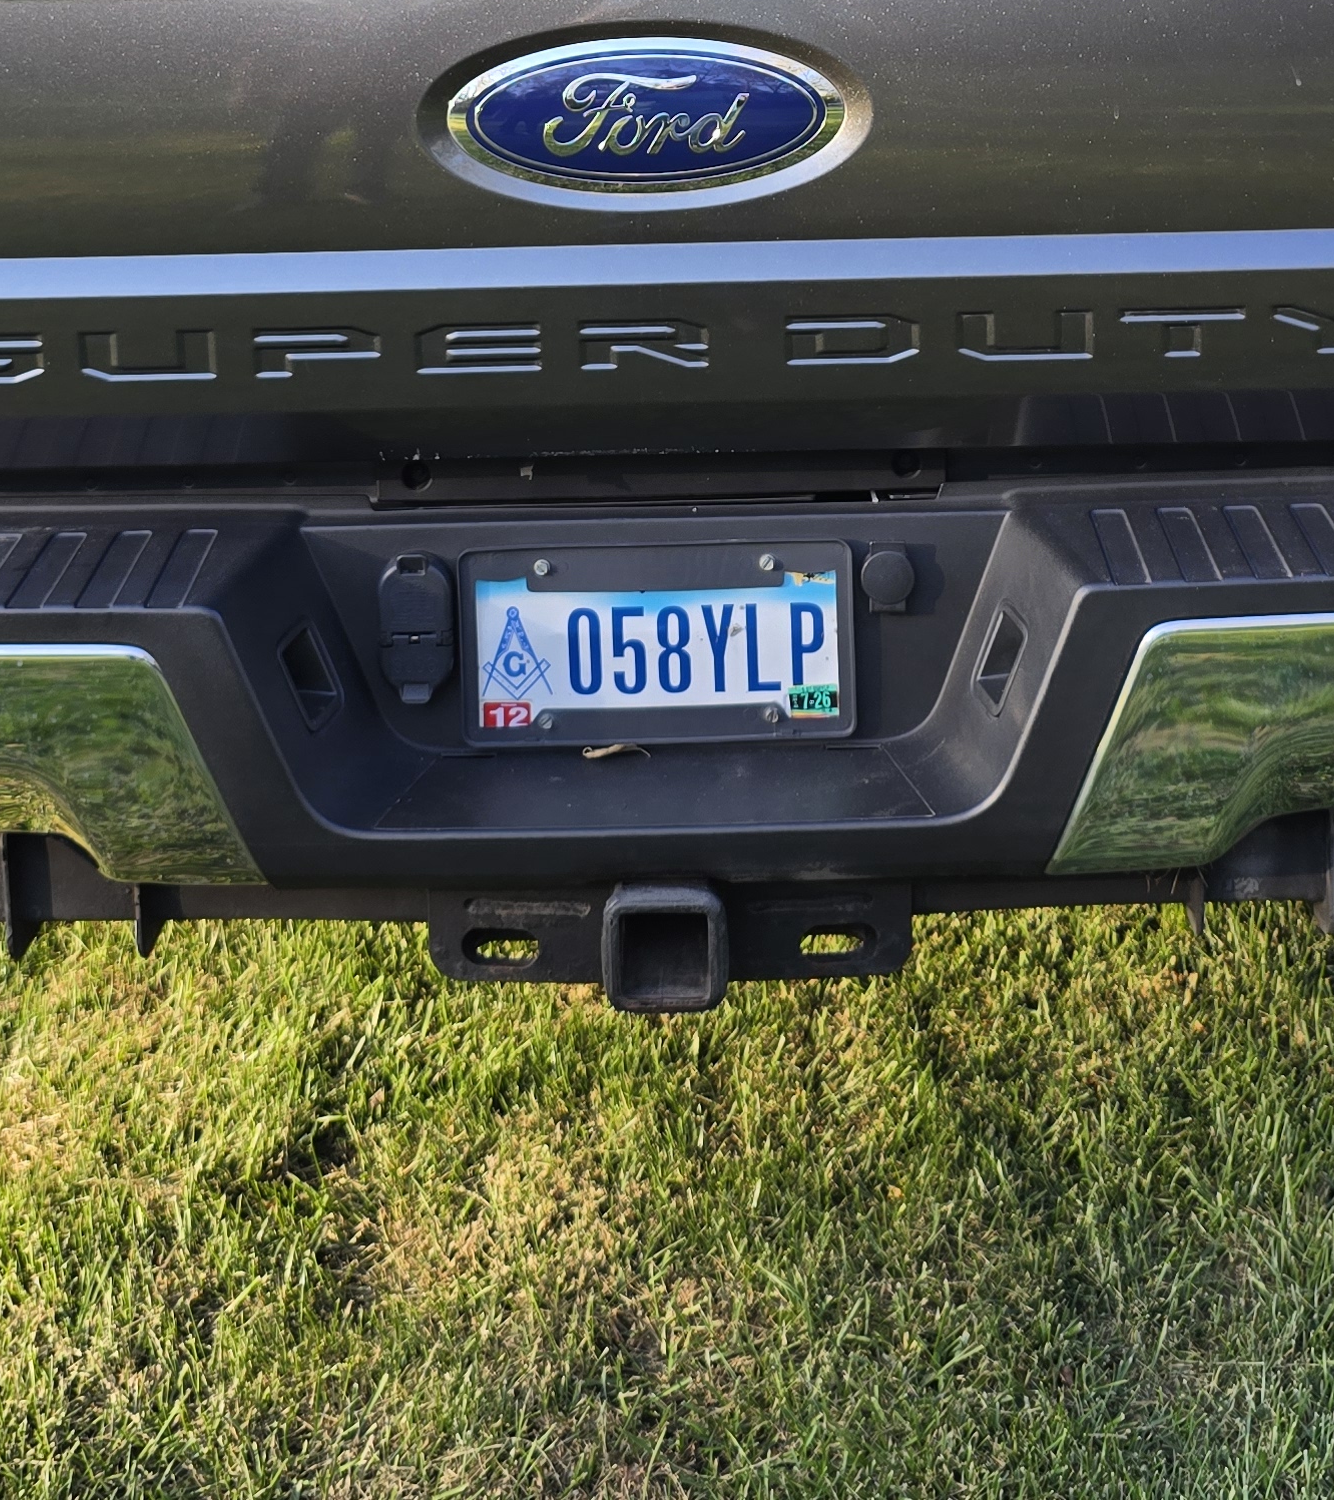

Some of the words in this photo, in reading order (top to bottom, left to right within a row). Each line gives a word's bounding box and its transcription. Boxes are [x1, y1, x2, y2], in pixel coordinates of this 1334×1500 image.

[542, 72, 750, 157] Ford
[567, 602, 825, 696] 058YLP
[489, 706, 529, 727] 12
